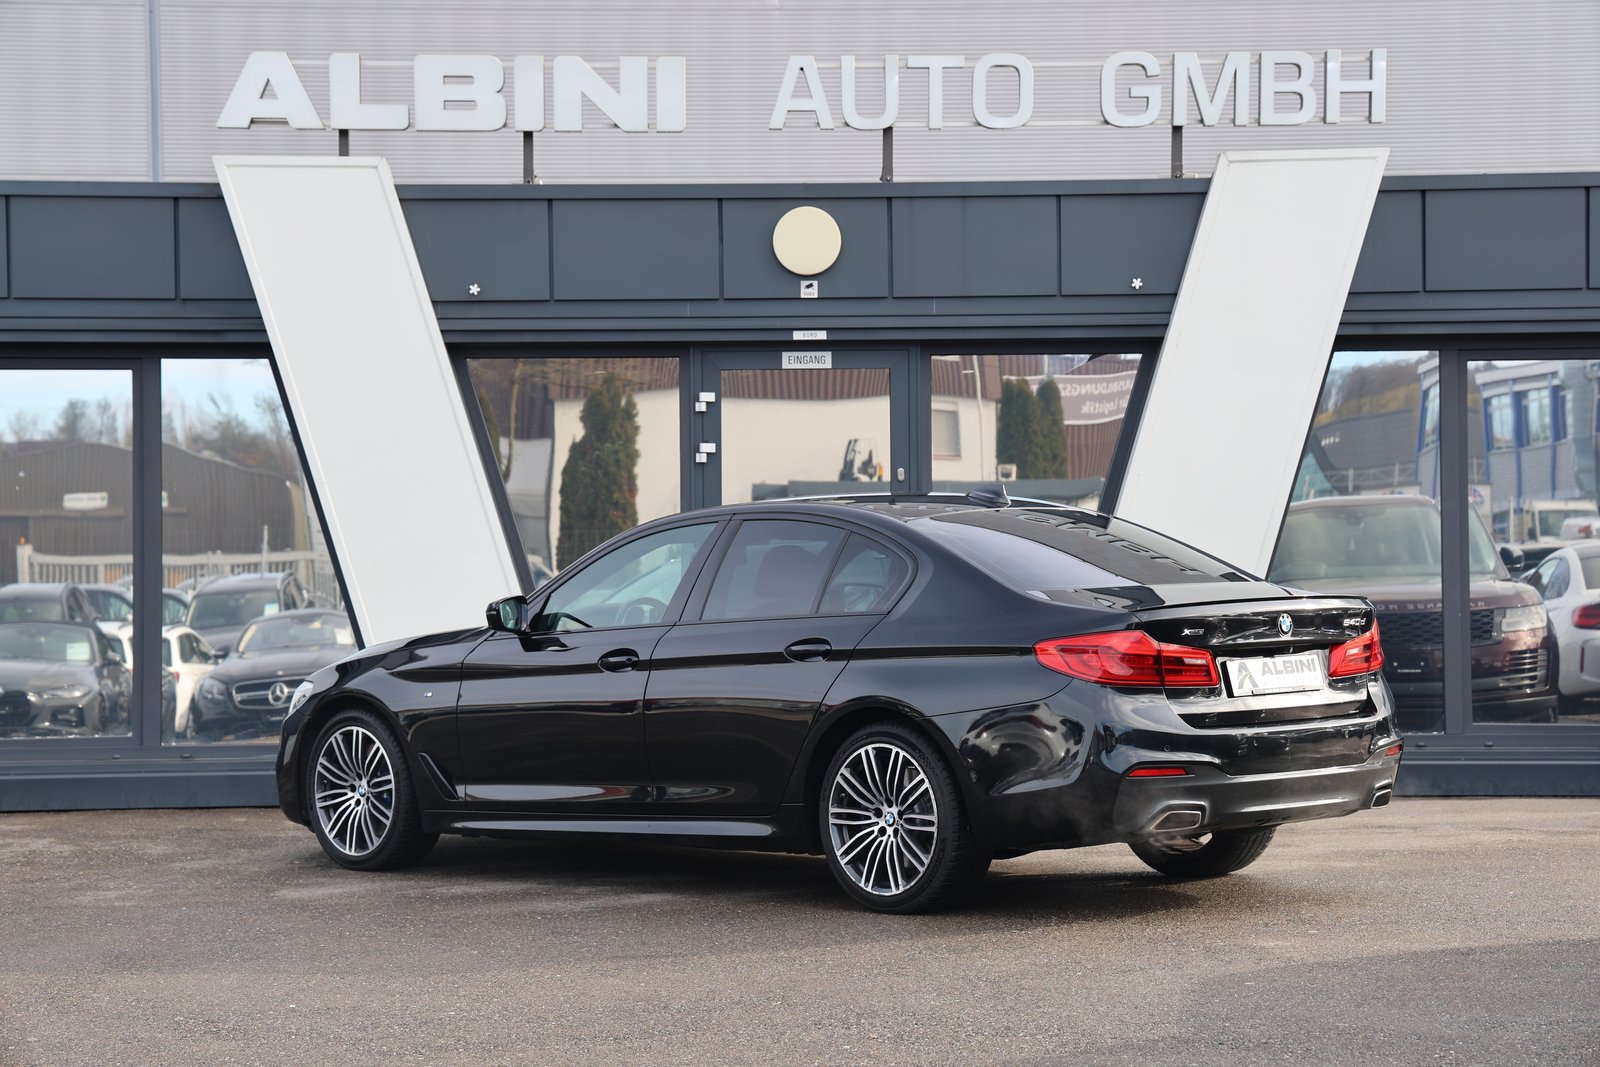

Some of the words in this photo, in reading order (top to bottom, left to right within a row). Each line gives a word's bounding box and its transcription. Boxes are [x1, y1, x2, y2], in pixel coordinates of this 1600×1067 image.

[216, 51, 687, 133] ALBINI
[769, 53, 1034, 131] AUTO
[1100, 48, 1388, 127] GMBH
[788, 355, 826, 364] EINGANG
[1343, 618, 1367, 627] 540d
[1262, 658, 1317, 676] ALBINI
